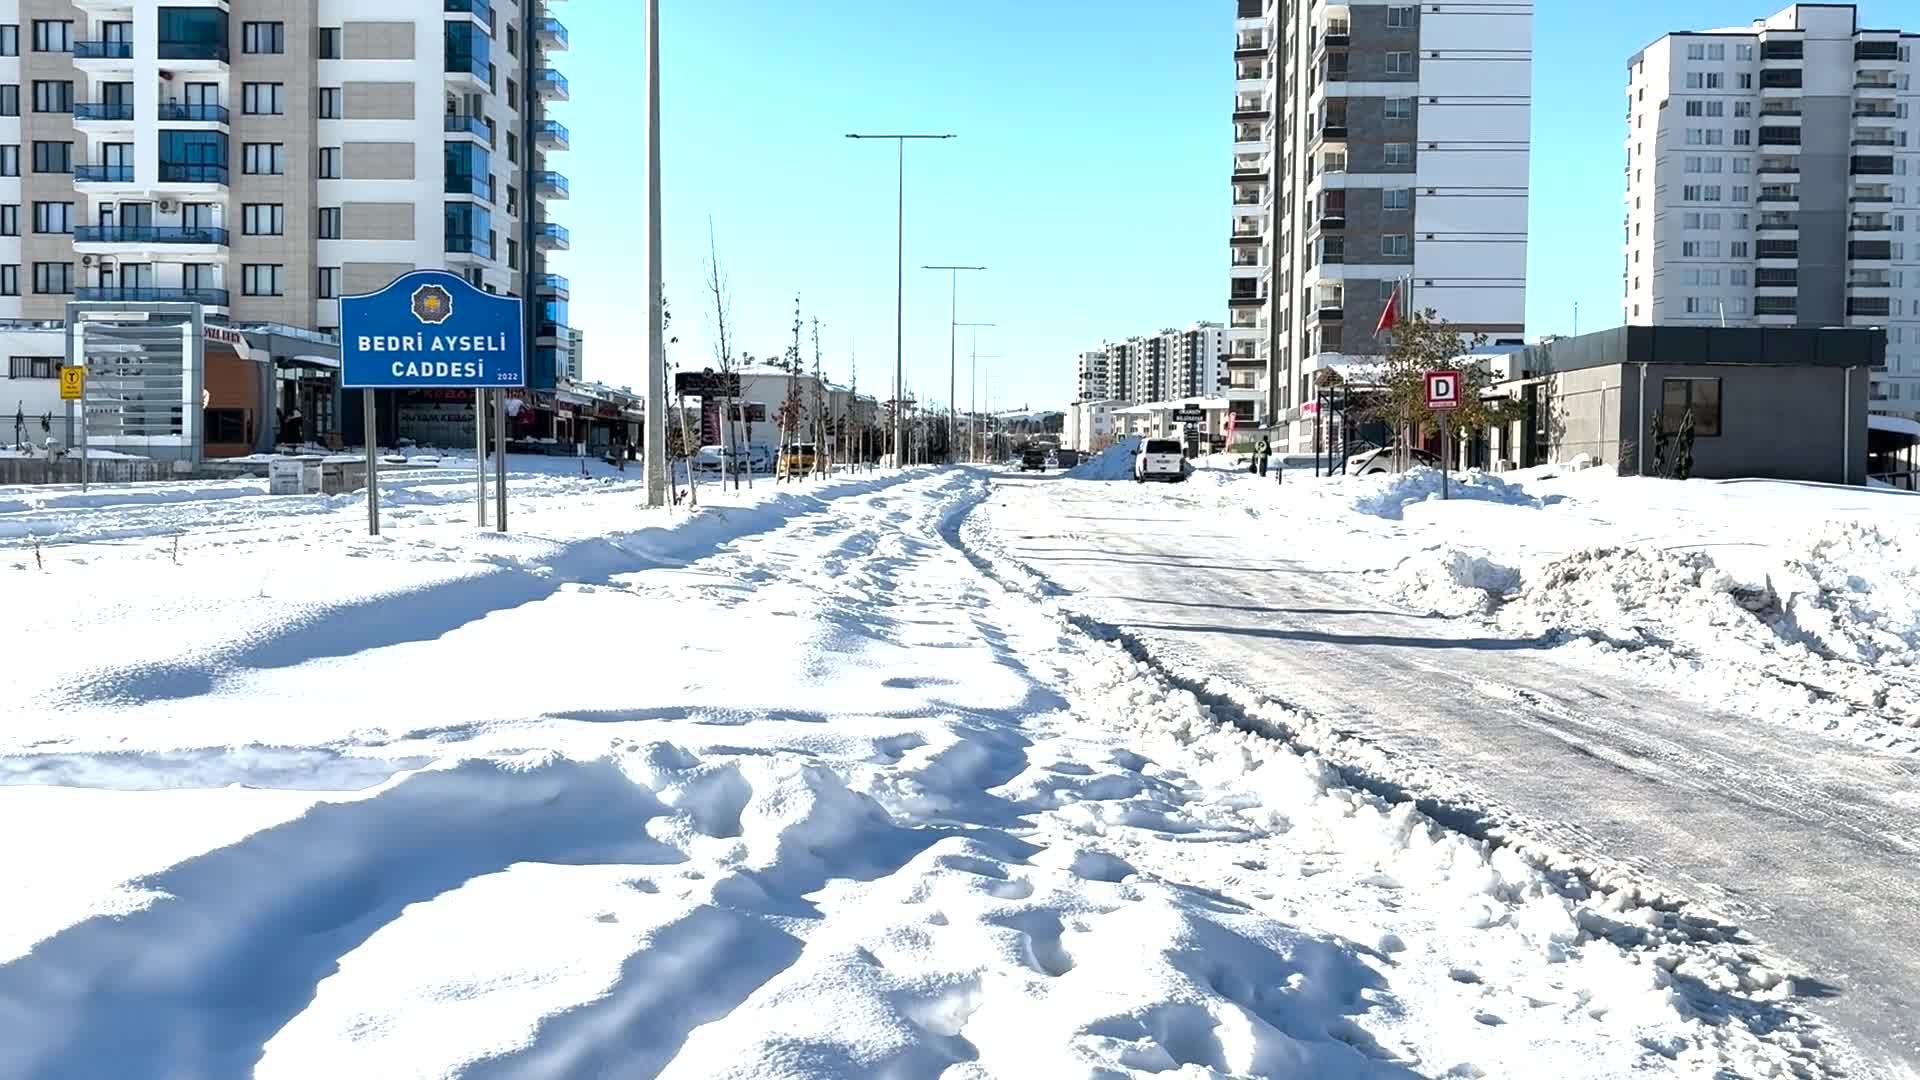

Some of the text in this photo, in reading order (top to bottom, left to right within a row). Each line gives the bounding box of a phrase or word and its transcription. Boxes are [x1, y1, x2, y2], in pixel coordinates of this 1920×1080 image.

[358, 332, 506, 352] BEDRİ AYSELİ
[392, 358, 484, 378] CADDESİ
[1435, 379, 1449, 396] D
